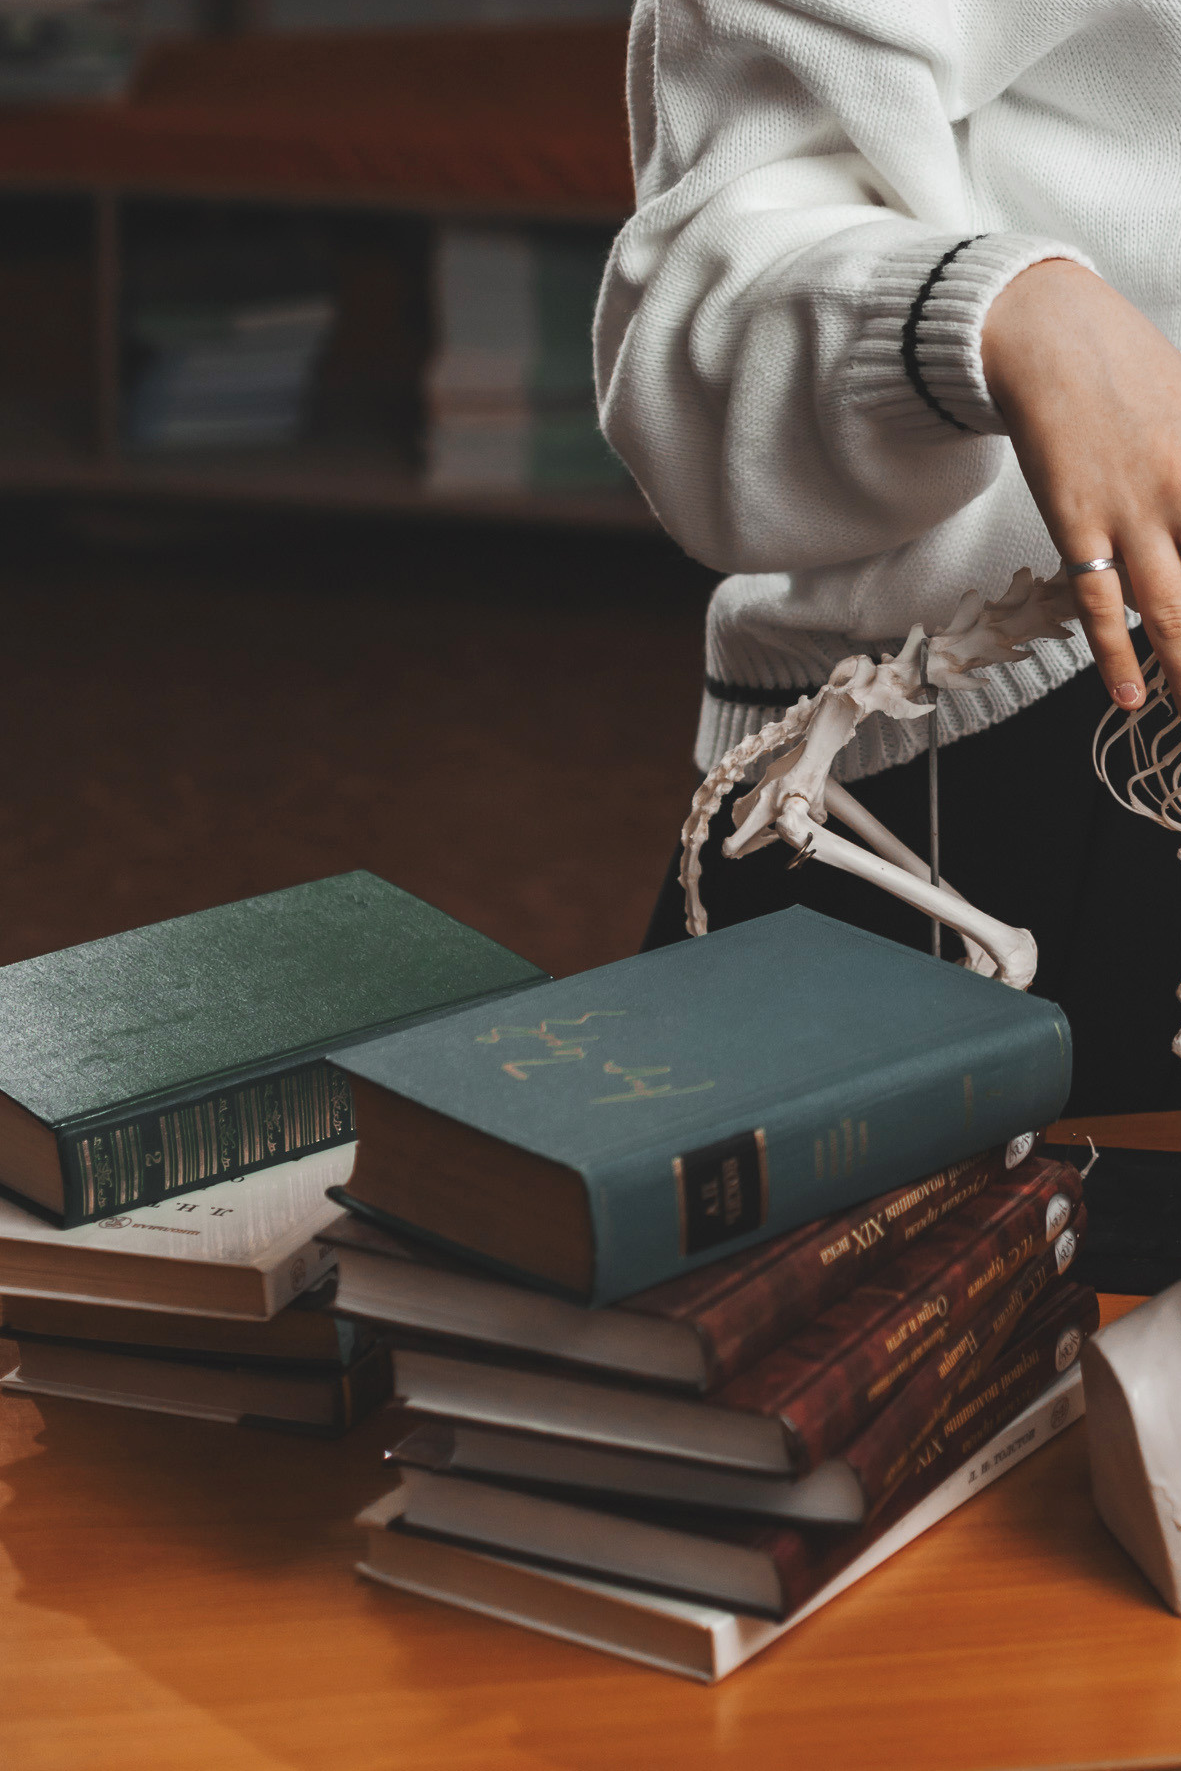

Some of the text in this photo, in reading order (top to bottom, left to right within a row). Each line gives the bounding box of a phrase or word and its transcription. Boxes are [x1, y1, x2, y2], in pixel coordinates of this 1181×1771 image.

[176, 1201, 234, 1217] Л. Н.
[851, 1212, 887, 1255] XIX
